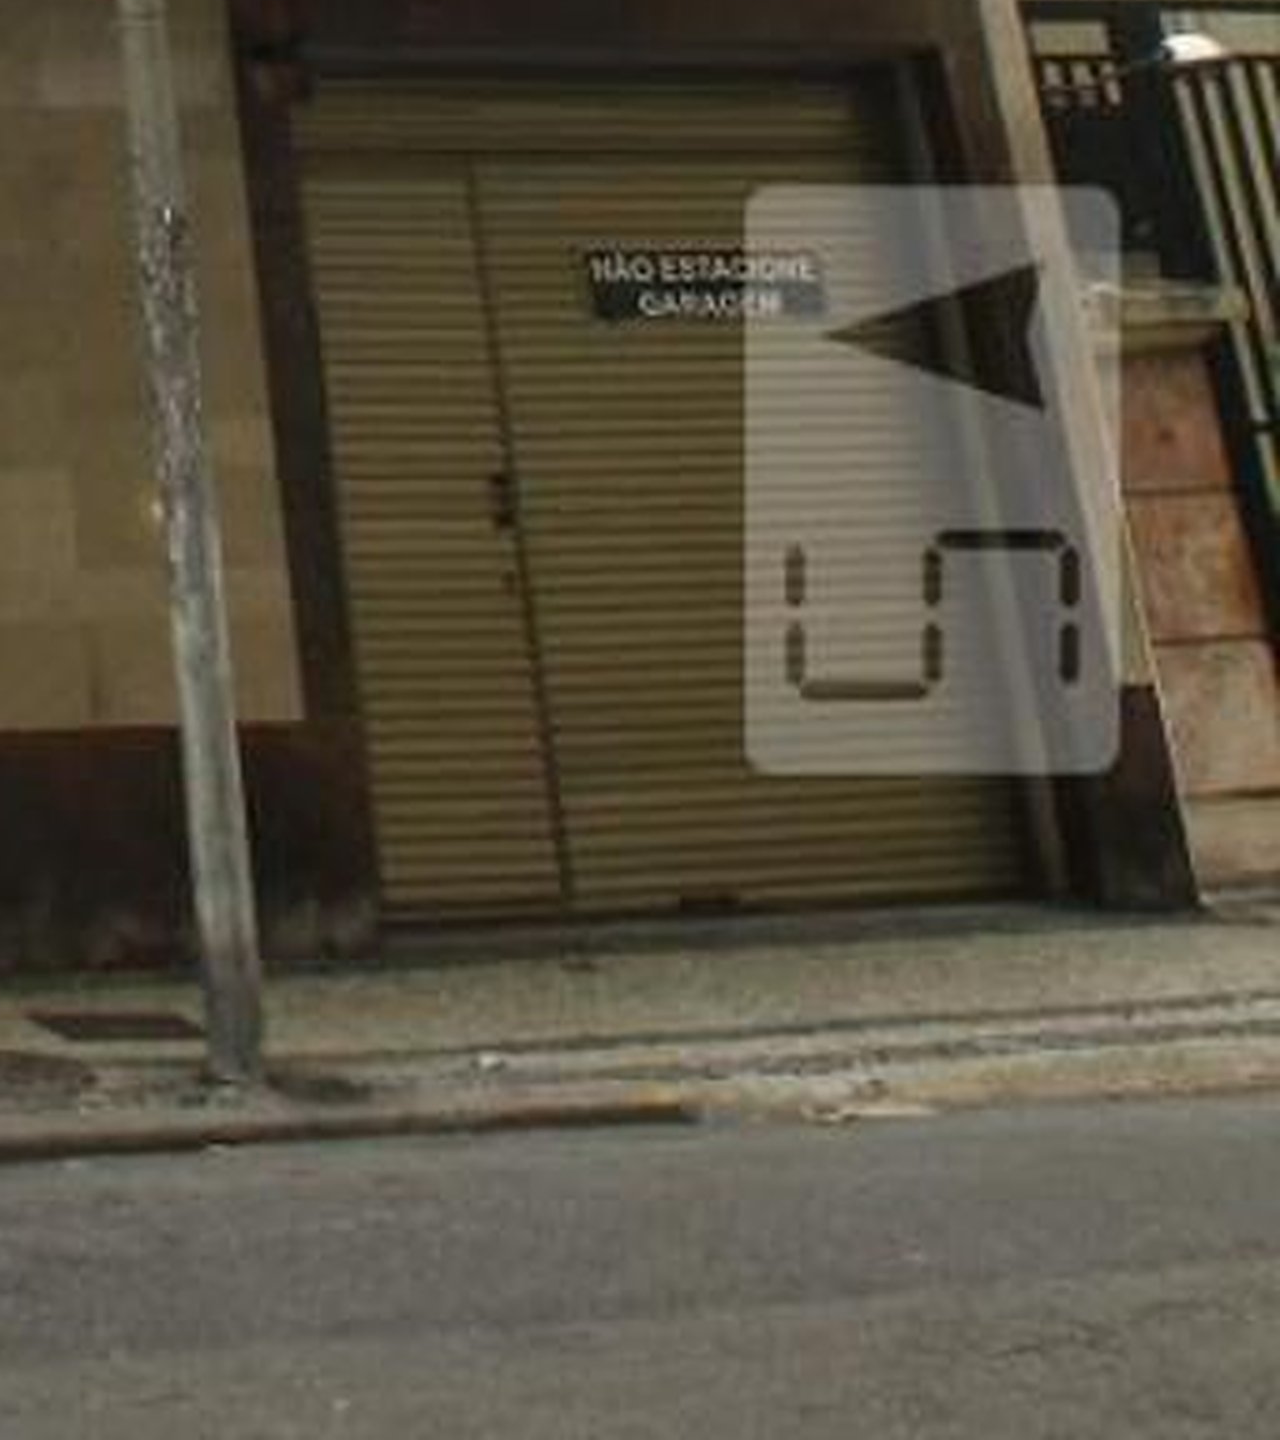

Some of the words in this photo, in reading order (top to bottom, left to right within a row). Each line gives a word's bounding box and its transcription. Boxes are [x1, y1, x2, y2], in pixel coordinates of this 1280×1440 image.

[592, 251, 653, 282] NÃO
[659, 254, 816, 282] ESTACIONE
[638, 288, 783, 317] GARAGEM
